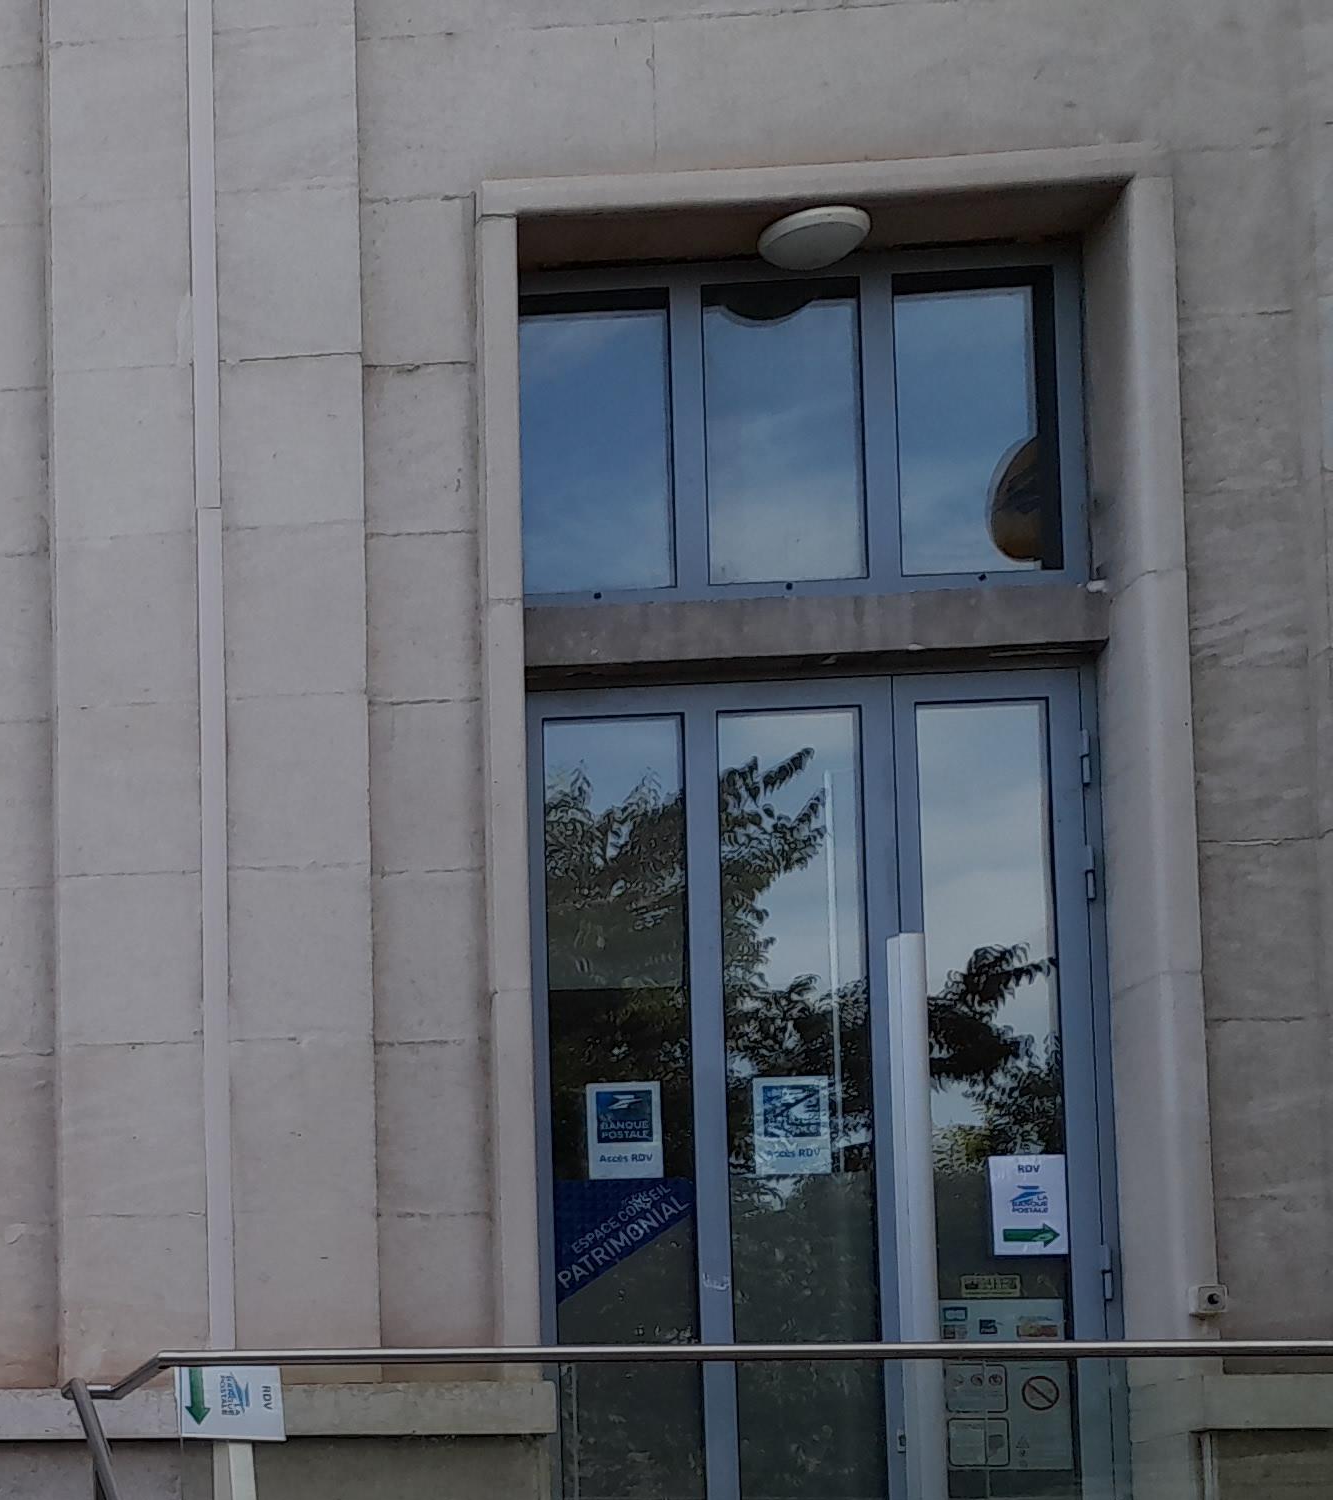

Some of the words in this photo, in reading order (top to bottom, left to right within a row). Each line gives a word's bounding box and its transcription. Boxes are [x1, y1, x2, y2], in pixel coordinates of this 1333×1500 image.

[600, 1120, 650, 1130] BANQUE
[601, 1130, 650, 1139] POSTALE
[798, 1147, 821, 1157] RDV
[631, 1152, 653, 1163] RDV
[1017, 1164, 1041, 1173] RDV
[571, 1217, 622, 1254] ESPACE
[617, 1184, 672, 1222] CONSEIL
[557, 1195, 691, 1289] PATRIMONIAL
[261, 1385, 274, 1411] RDV
